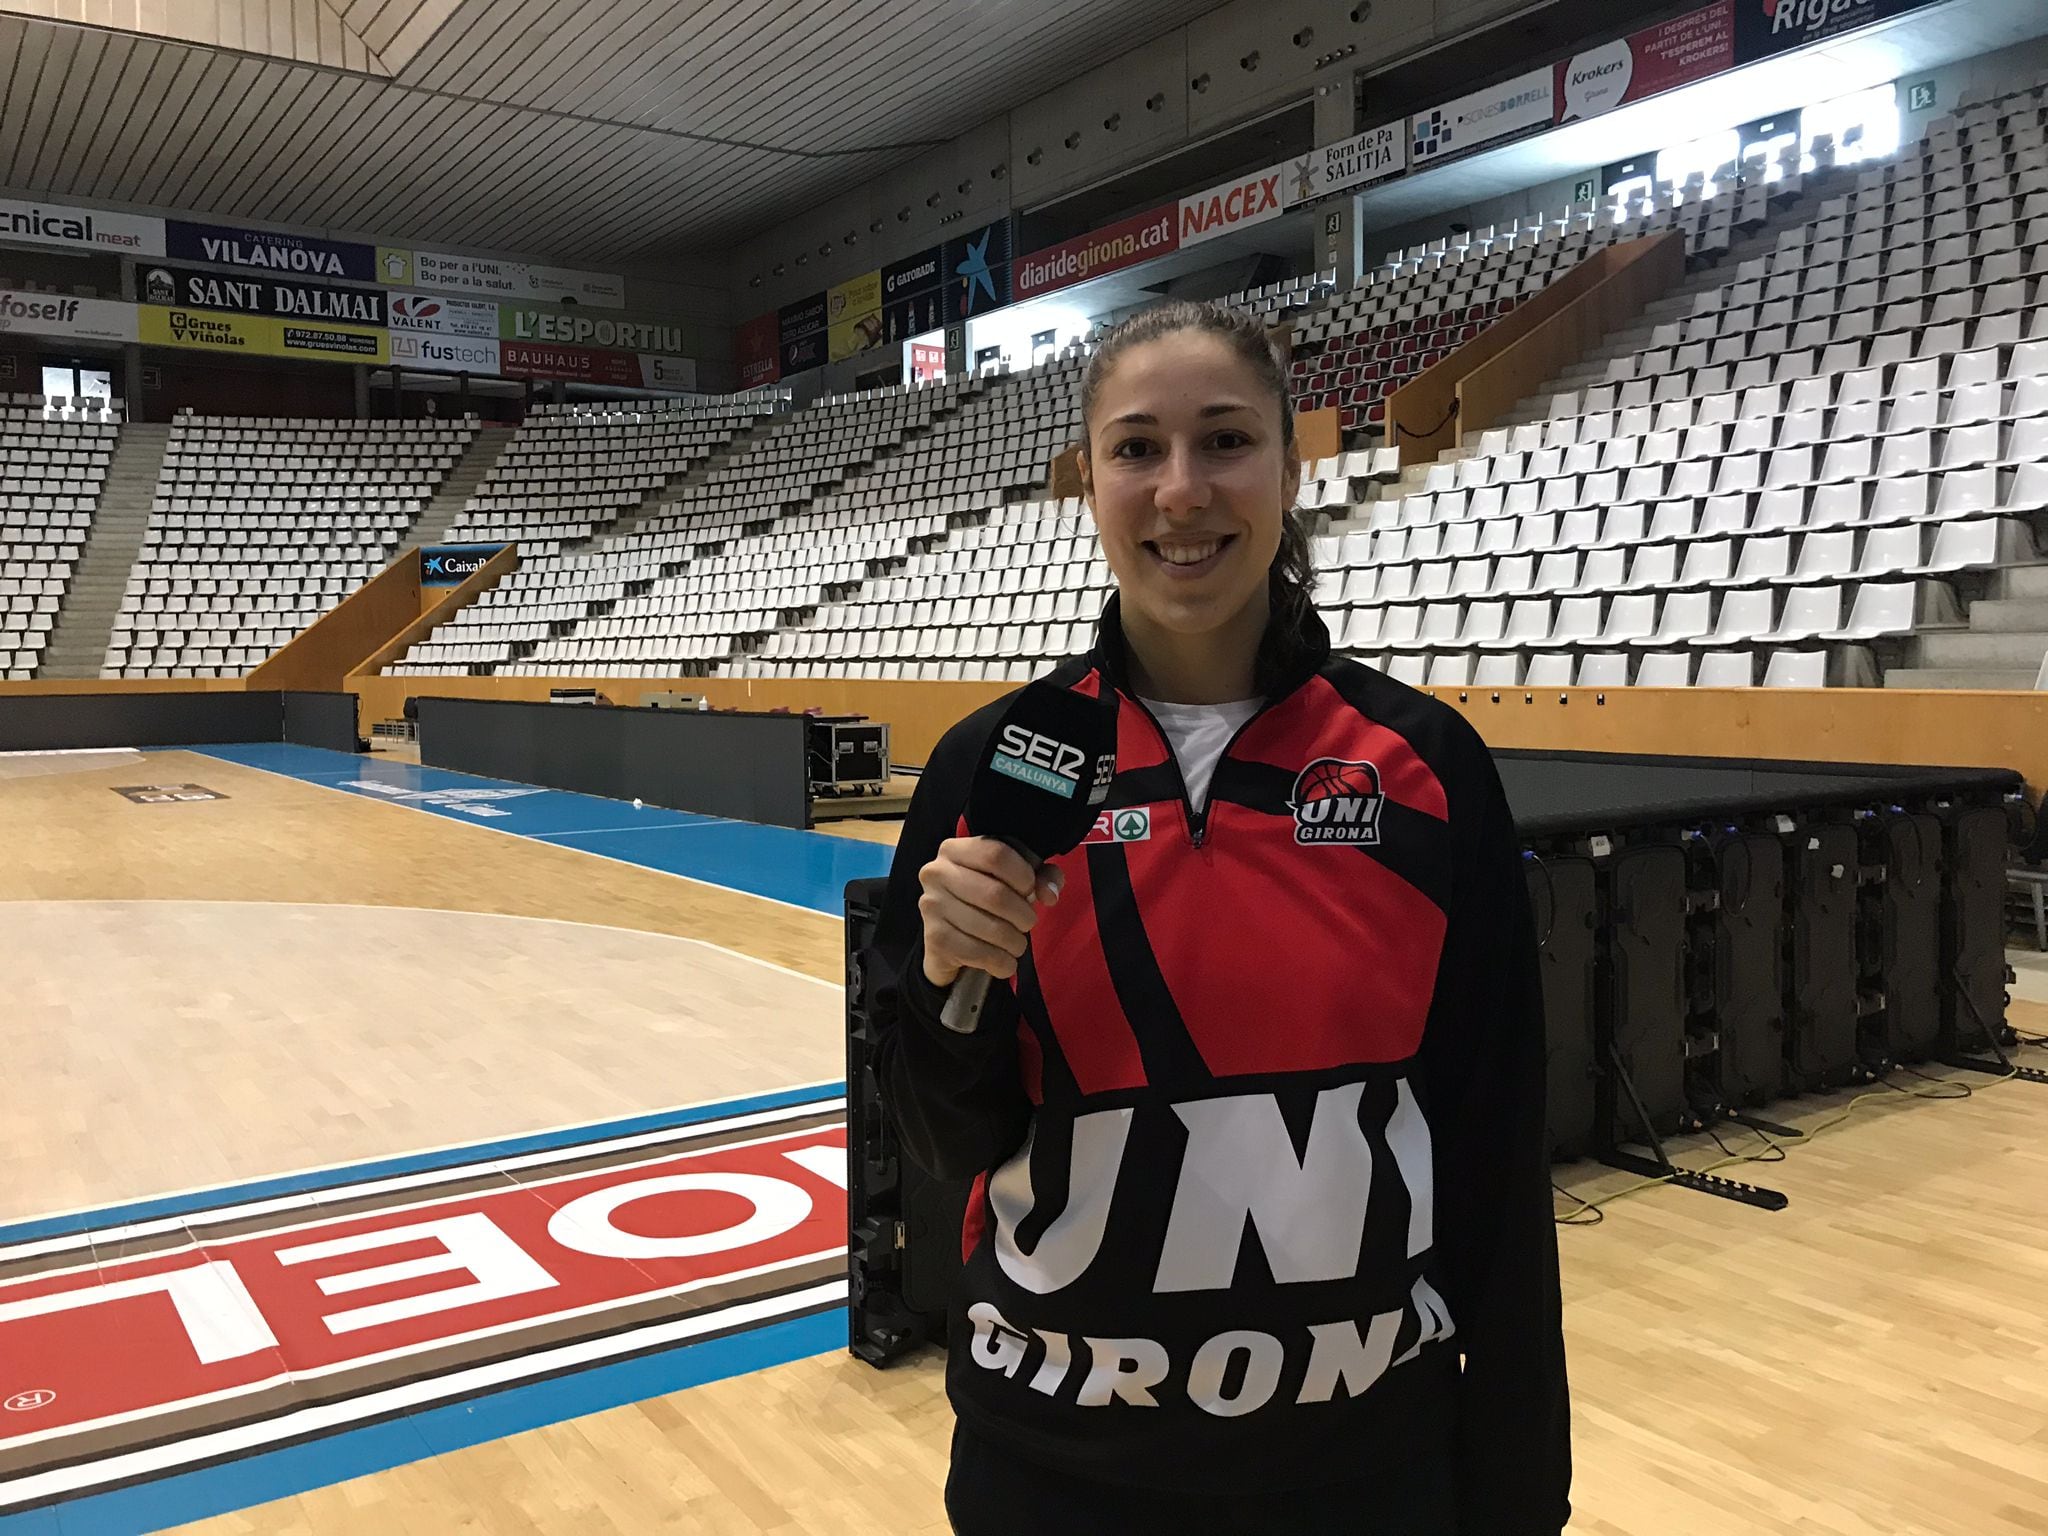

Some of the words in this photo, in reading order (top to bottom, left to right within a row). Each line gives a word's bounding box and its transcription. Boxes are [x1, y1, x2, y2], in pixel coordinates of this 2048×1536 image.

[1709, 5, 1728, 19] DEL
[1772, 0, 1868, 34] Riga
[1644, 35, 1678, 54] PARTIT
[1680, 30, 1693, 42] DE
[1660, 36, 1713, 60] T'ESPEREM
[1715, 31, 1728, 41] AL
[1679, 42, 1728, 66] KROKERS!
[1572, 59, 1624, 86] Krokers
[1326, 148, 1355, 164] Forn
[1358, 135, 1374, 151] de
[1377, 129, 1393, 145] Pa
[1326, 146, 1392, 182] SALITJA
[1182, 173, 1280, 239] NACEX
[96, 232, 142, 248] meat
[244, 232, 304, 249] CATERING
[1020, 216, 1169, 290] diaridegirona.cat
[201, 237, 345, 276] VILANOVA
[420, 256, 437, 268] Bo
[439, 261, 458, 272] per
[462, 264, 469, 272] a
[421, 271, 437, 282] Bo
[440, 274, 458, 285] per
[462, 277, 469, 285] a
[472, 276, 482, 287] la
[485, 279, 516, 291] salut.
[887, 275, 895, 293] G
[897, 260, 936, 286] GATORADE
[188, 277, 262, 310] SANT
[274, 285, 381, 323] DALMAI
[188, 317, 232, 332] Grues
[392, 316, 441, 330] VALENT
[515, 311, 683, 353] L'ESPORTIU
[188, 328, 246, 346] Viñolas
[421, 340, 497, 364] fustech
[507, 350, 590, 369] BAUHAUS
[654, 360, 664, 381] 5
[743, 357, 773, 378] ESTRELLA
[995, 757, 1067, 794] CATALUNYA
[1301, 797, 1378, 824] UNI
[1300, 826, 1375, 841] GIRONA
[989, 1077, 1434, 1295] UNI
[0, 1145, 848, 1365] OEL
[967, 1274, 1456, 1418] GIRONA
